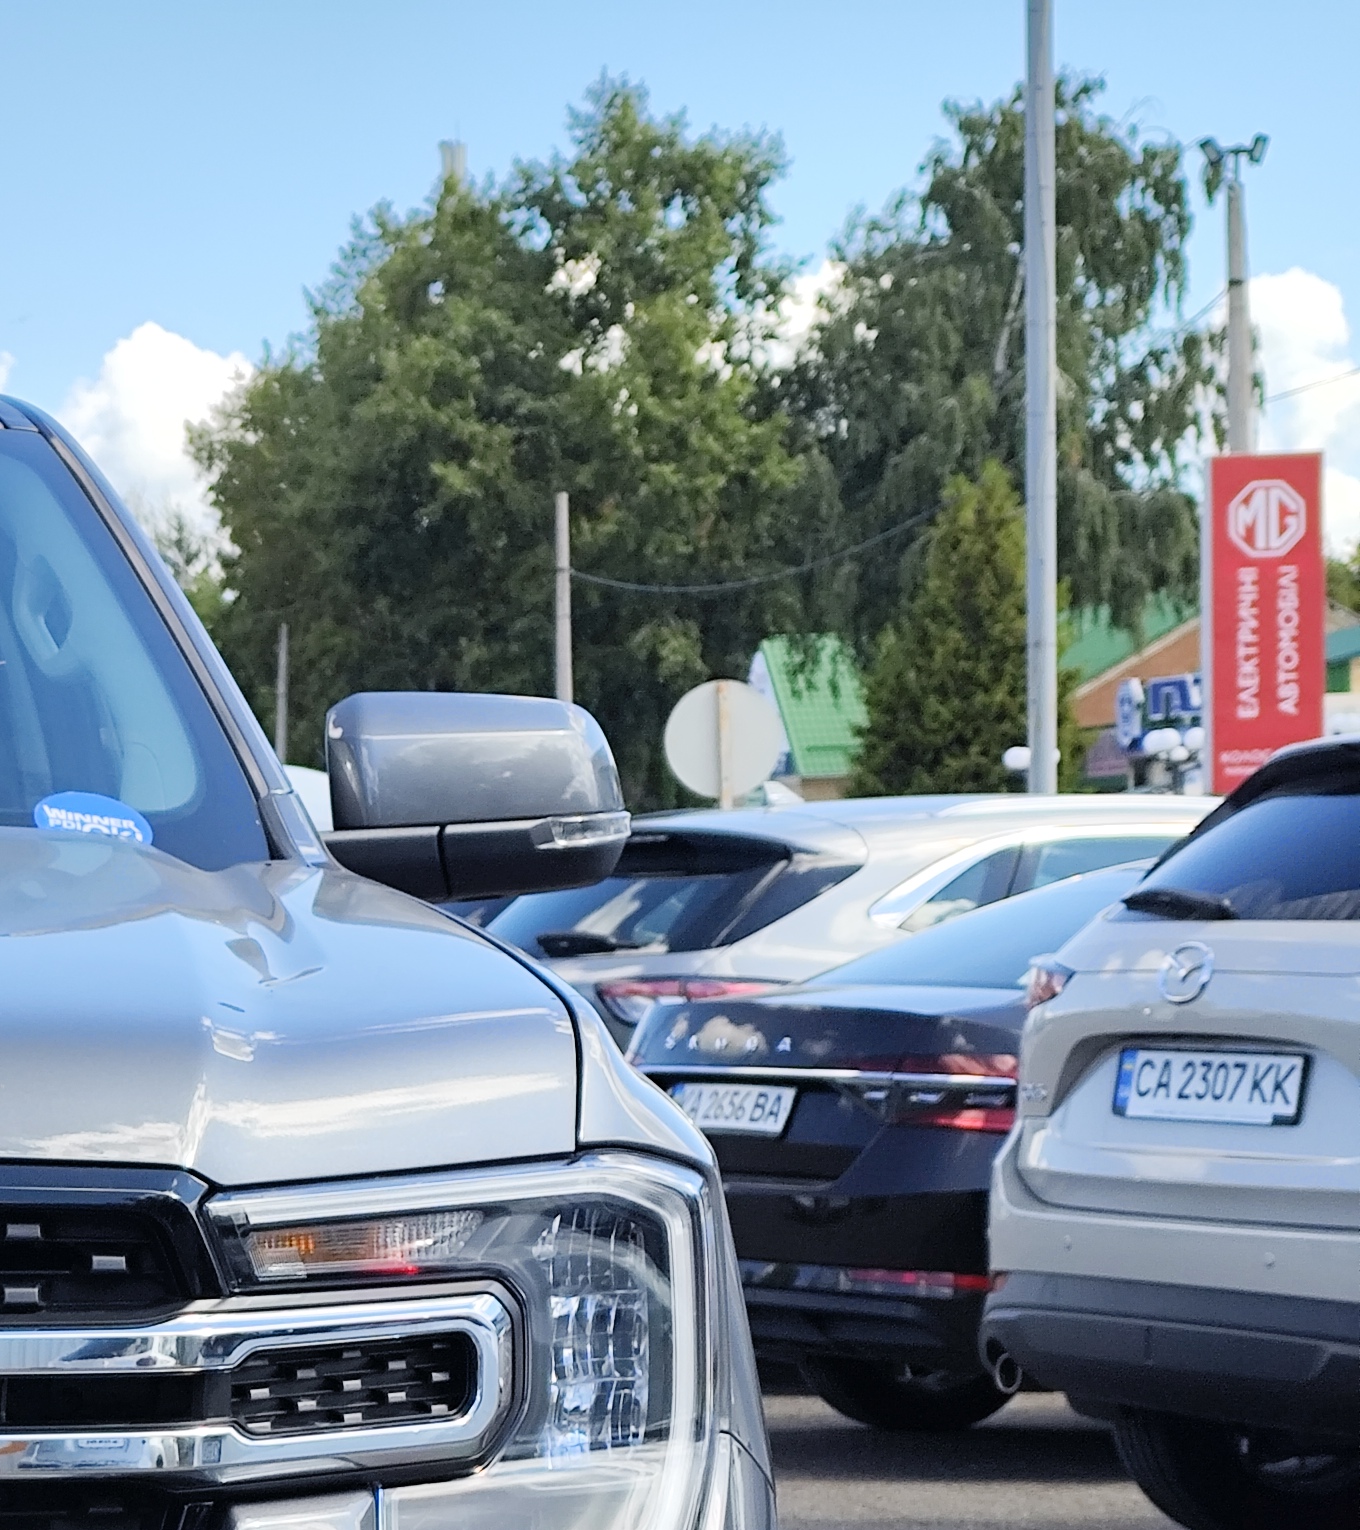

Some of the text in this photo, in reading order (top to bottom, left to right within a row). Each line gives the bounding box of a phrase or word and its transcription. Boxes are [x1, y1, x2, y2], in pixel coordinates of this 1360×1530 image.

[1234, 487, 1299, 549] MG
[42, 803, 138, 830] WINNER
[1135, 1058, 1297, 1106] CA 2307 KK
